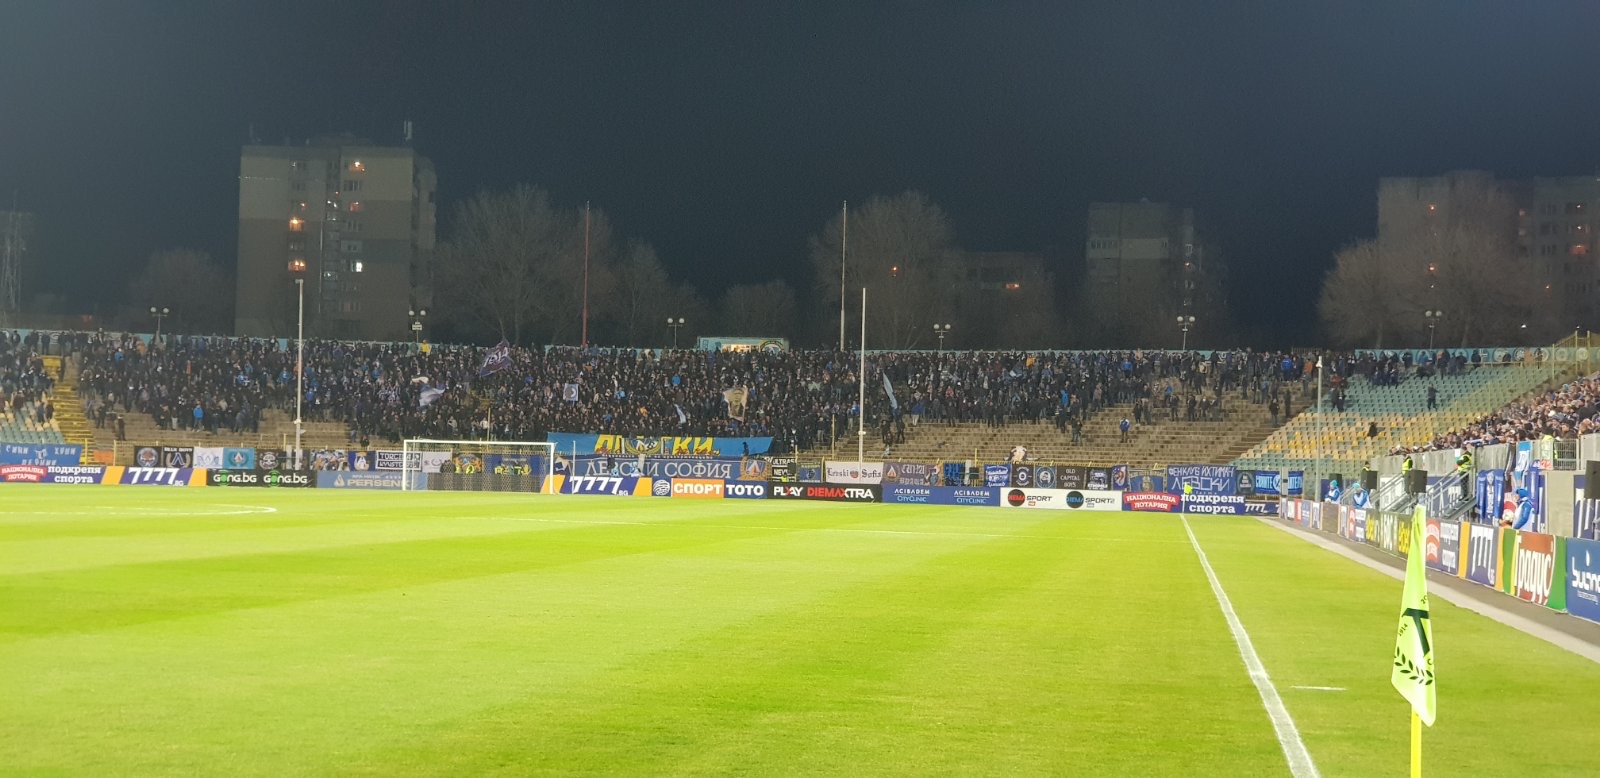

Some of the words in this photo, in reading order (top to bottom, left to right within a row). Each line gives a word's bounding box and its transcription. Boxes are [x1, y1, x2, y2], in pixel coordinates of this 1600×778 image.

[48, 466, 102, 476] подкрепя
[664, 461, 732, 479] СОФИЯ
[54, 475, 94, 485] спорта
[673, 482, 723, 495] СПОРТ
[726, 484, 765, 497] ТОТО
[773, 486, 803, 497] PLAY
[1181, 494, 1245, 505] подкрепя
[1189, 504, 1236, 515] спорта
